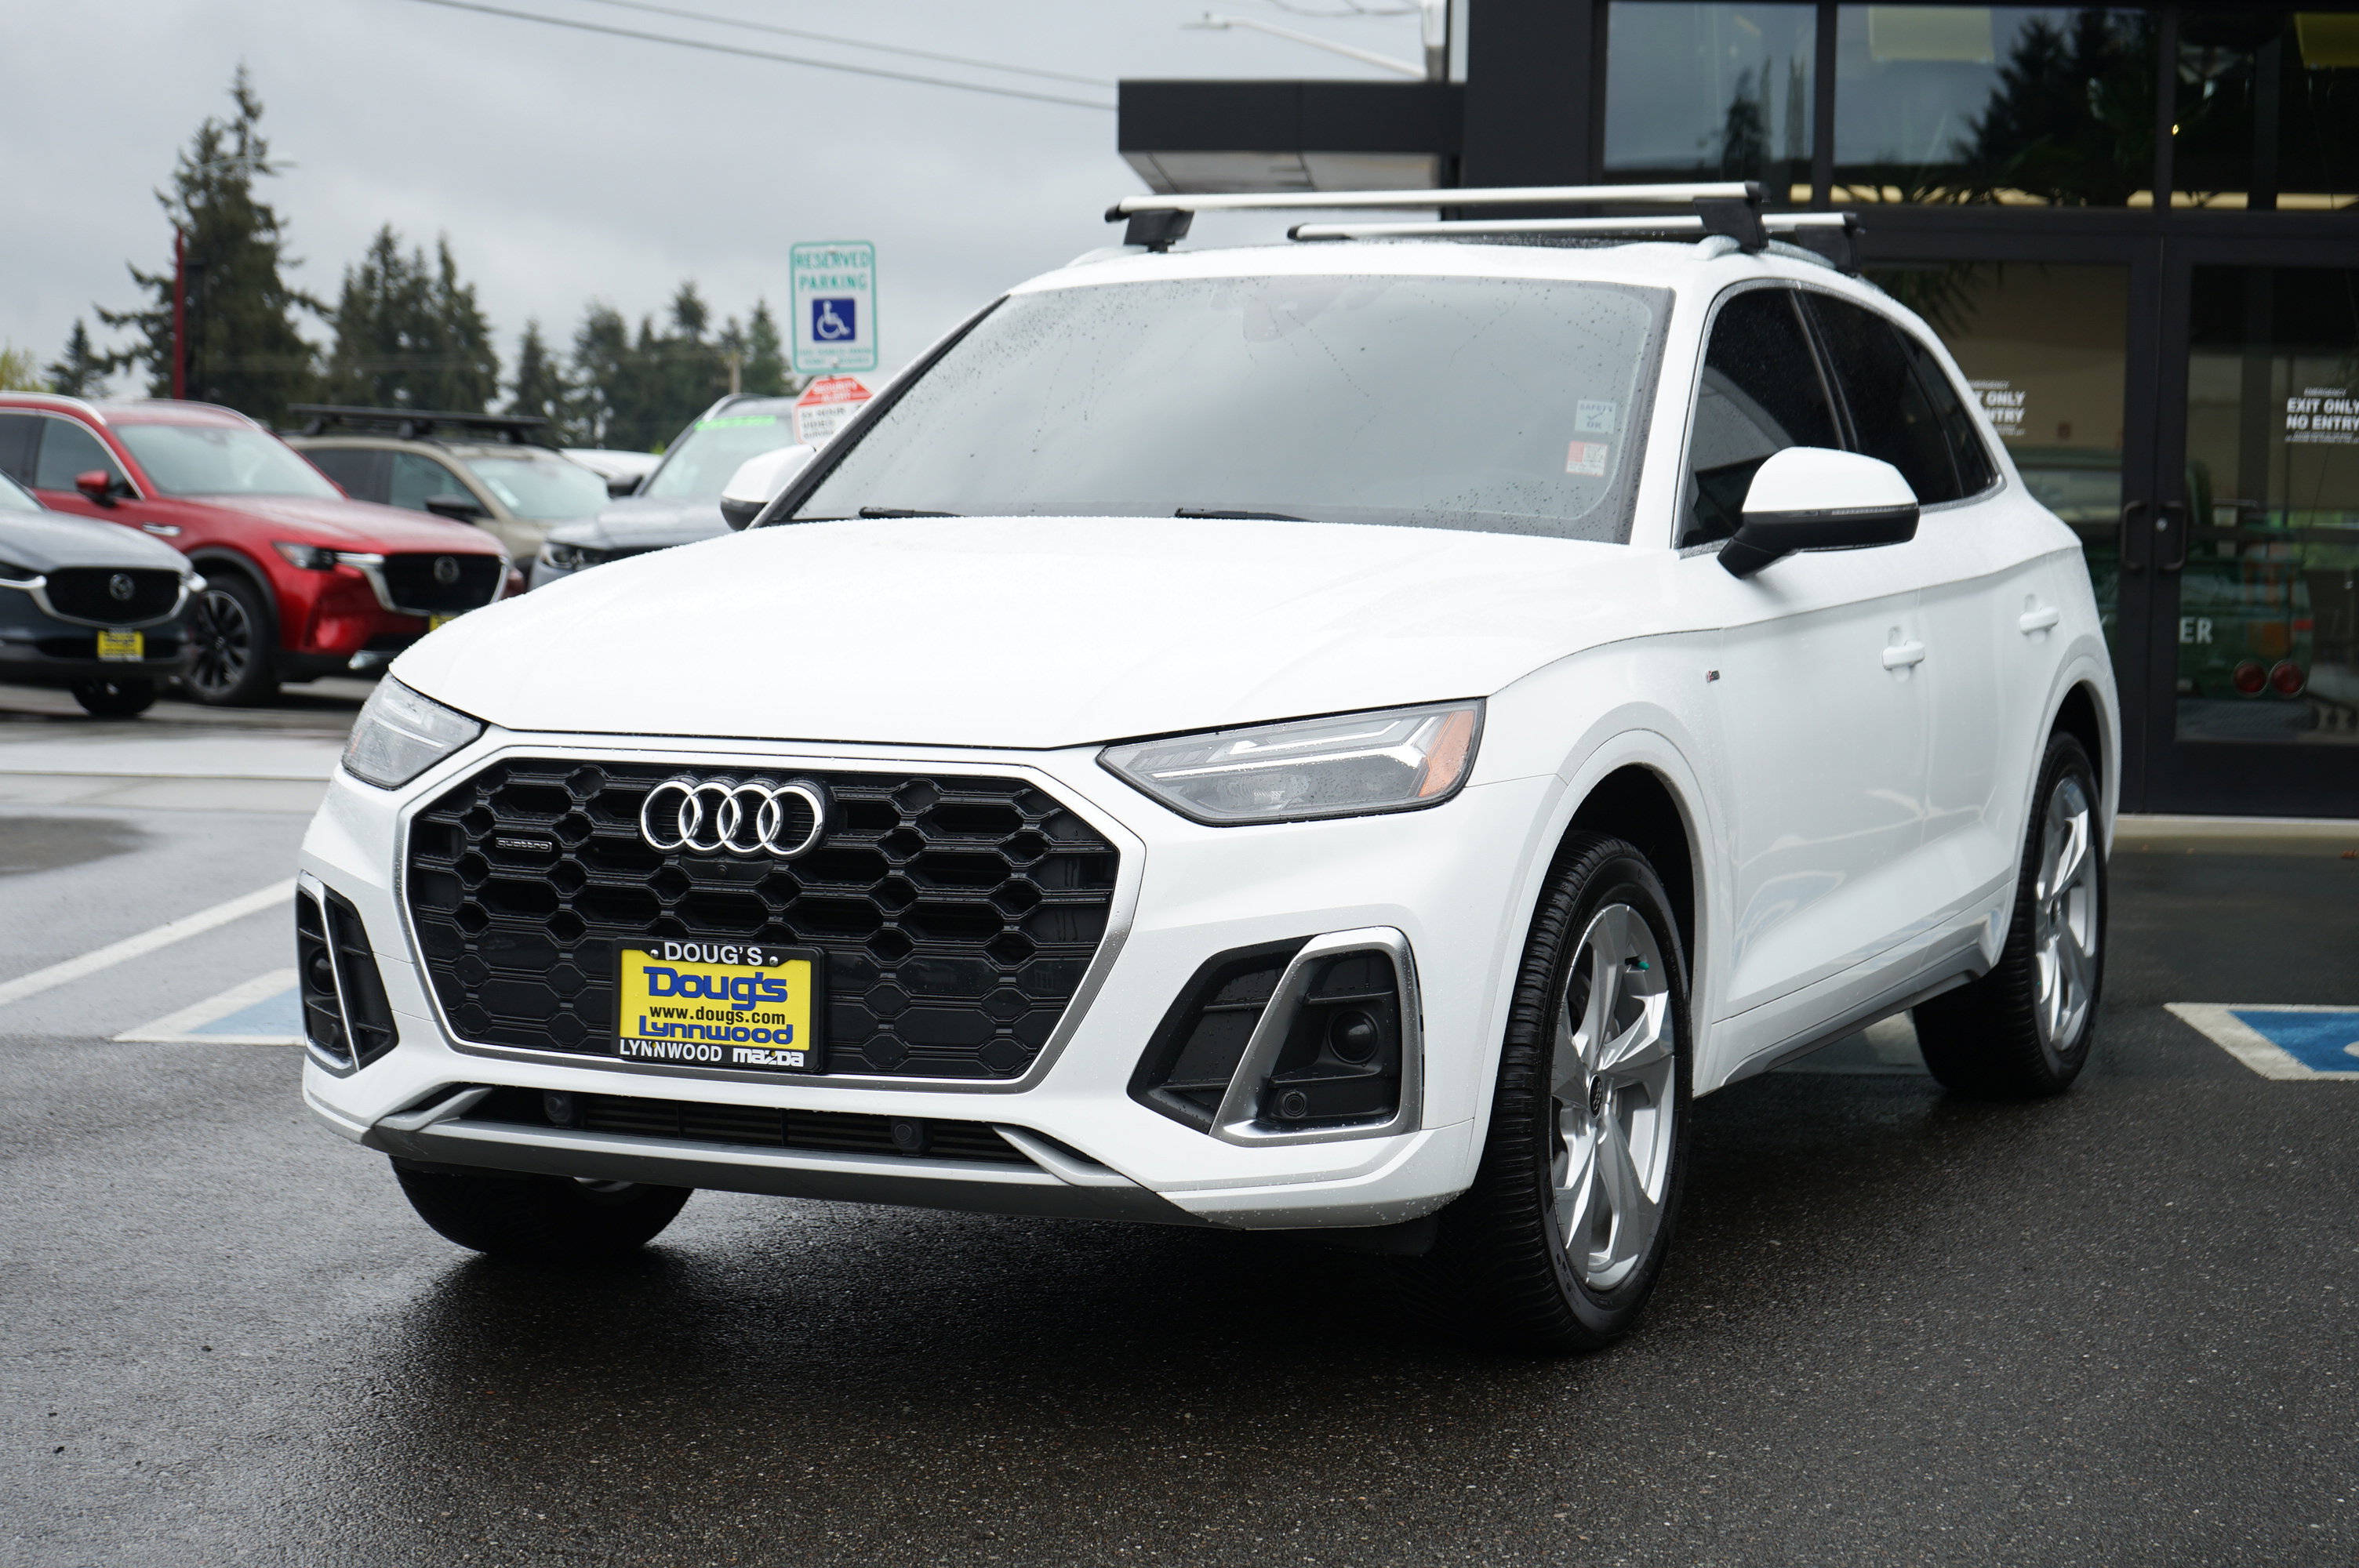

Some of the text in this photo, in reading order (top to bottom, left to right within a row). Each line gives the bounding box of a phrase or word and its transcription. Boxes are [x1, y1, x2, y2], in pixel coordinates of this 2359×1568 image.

[795, 252, 869, 269] RESERVED
[798, 273, 867, 290] PARKING
[1986, 390, 2026, 406] ONLY
[2287, 397, 2359, 414] EXIT ONLY
[2286, 414, 2359, 431] NO ENTRY
[497, 839, 549, 851] quattro
[664, 942, 763, 966] DOUG'S
[643, 966, 788, 1011] Doug's
[649, 1006, 786, 1025] www.dougs.com
[639, 1015, 794, 1045] Lynnwood
[620, 1040, 722, 1062] LYNNWOOD
